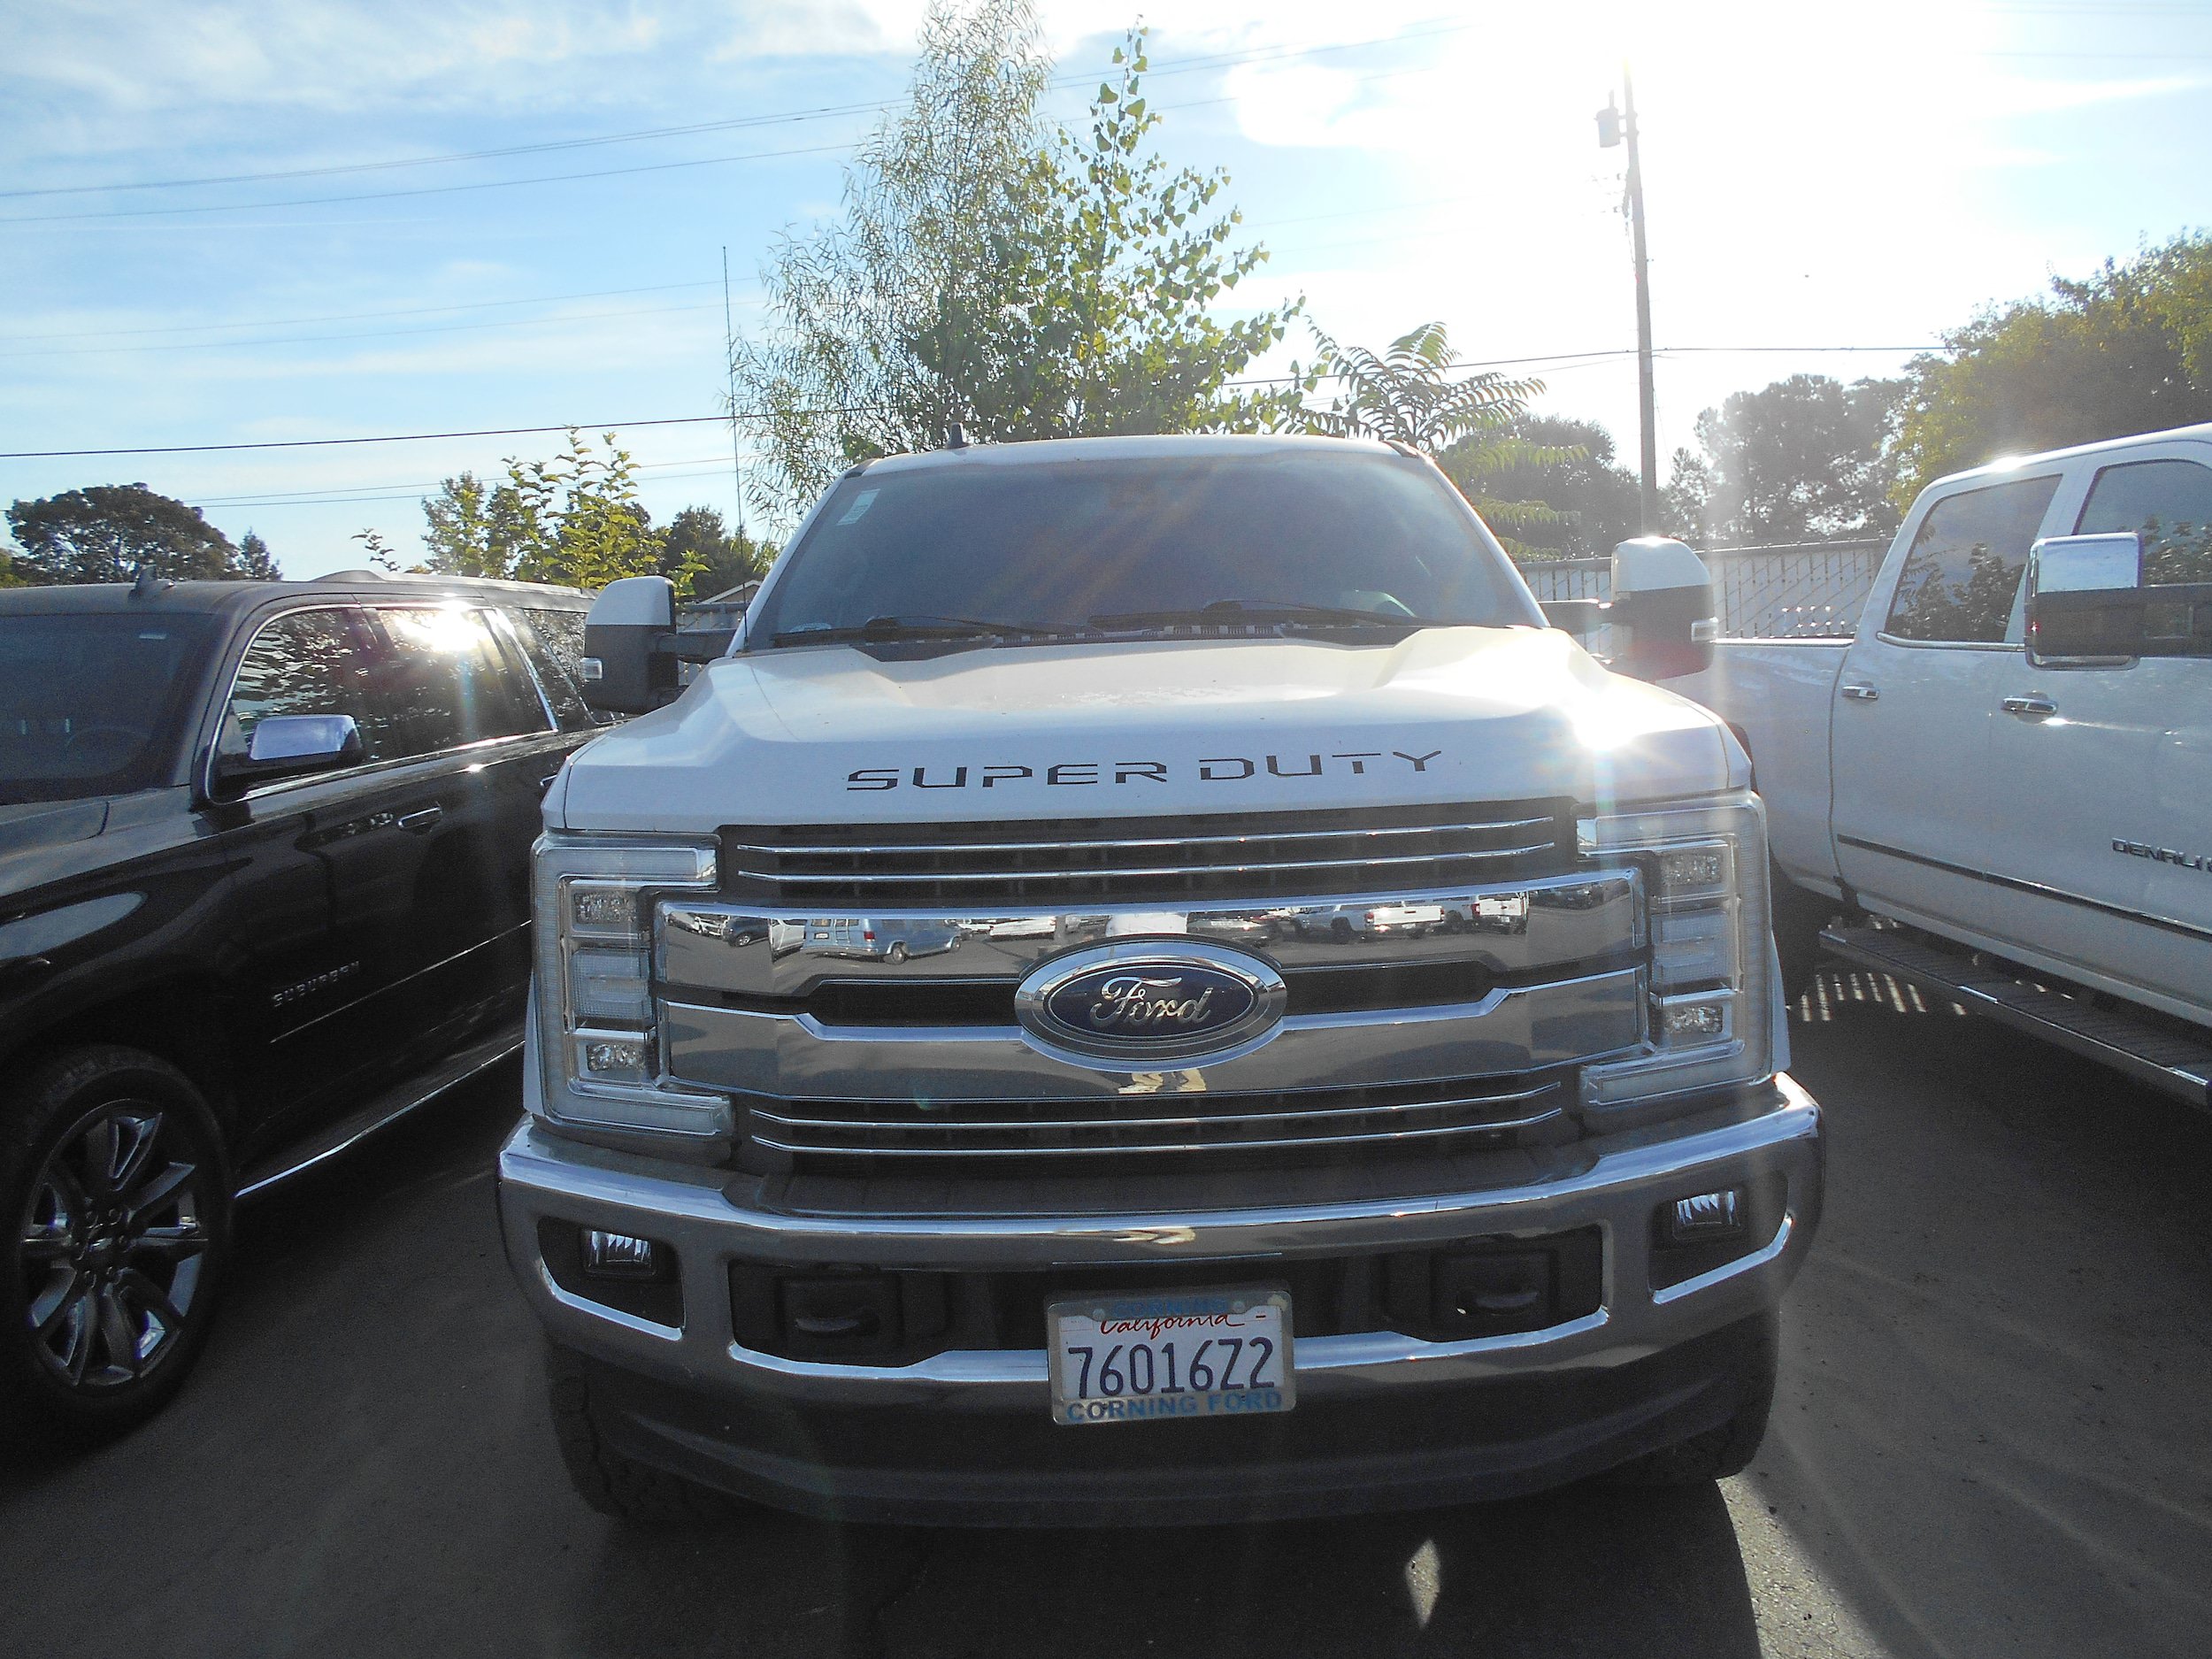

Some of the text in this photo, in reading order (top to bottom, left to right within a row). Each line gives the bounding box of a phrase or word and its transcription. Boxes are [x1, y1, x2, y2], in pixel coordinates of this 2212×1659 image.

[847, 750, 1442, 791] SUPER DUTY
[2111, 837, 2202, 872] DENALI
[1089, 976, 1214, 1024] Ford
[1068, 1337, 1275, 1400] 76016Z2
[1066, 1390, 1283, 1423] CORNING FORD
